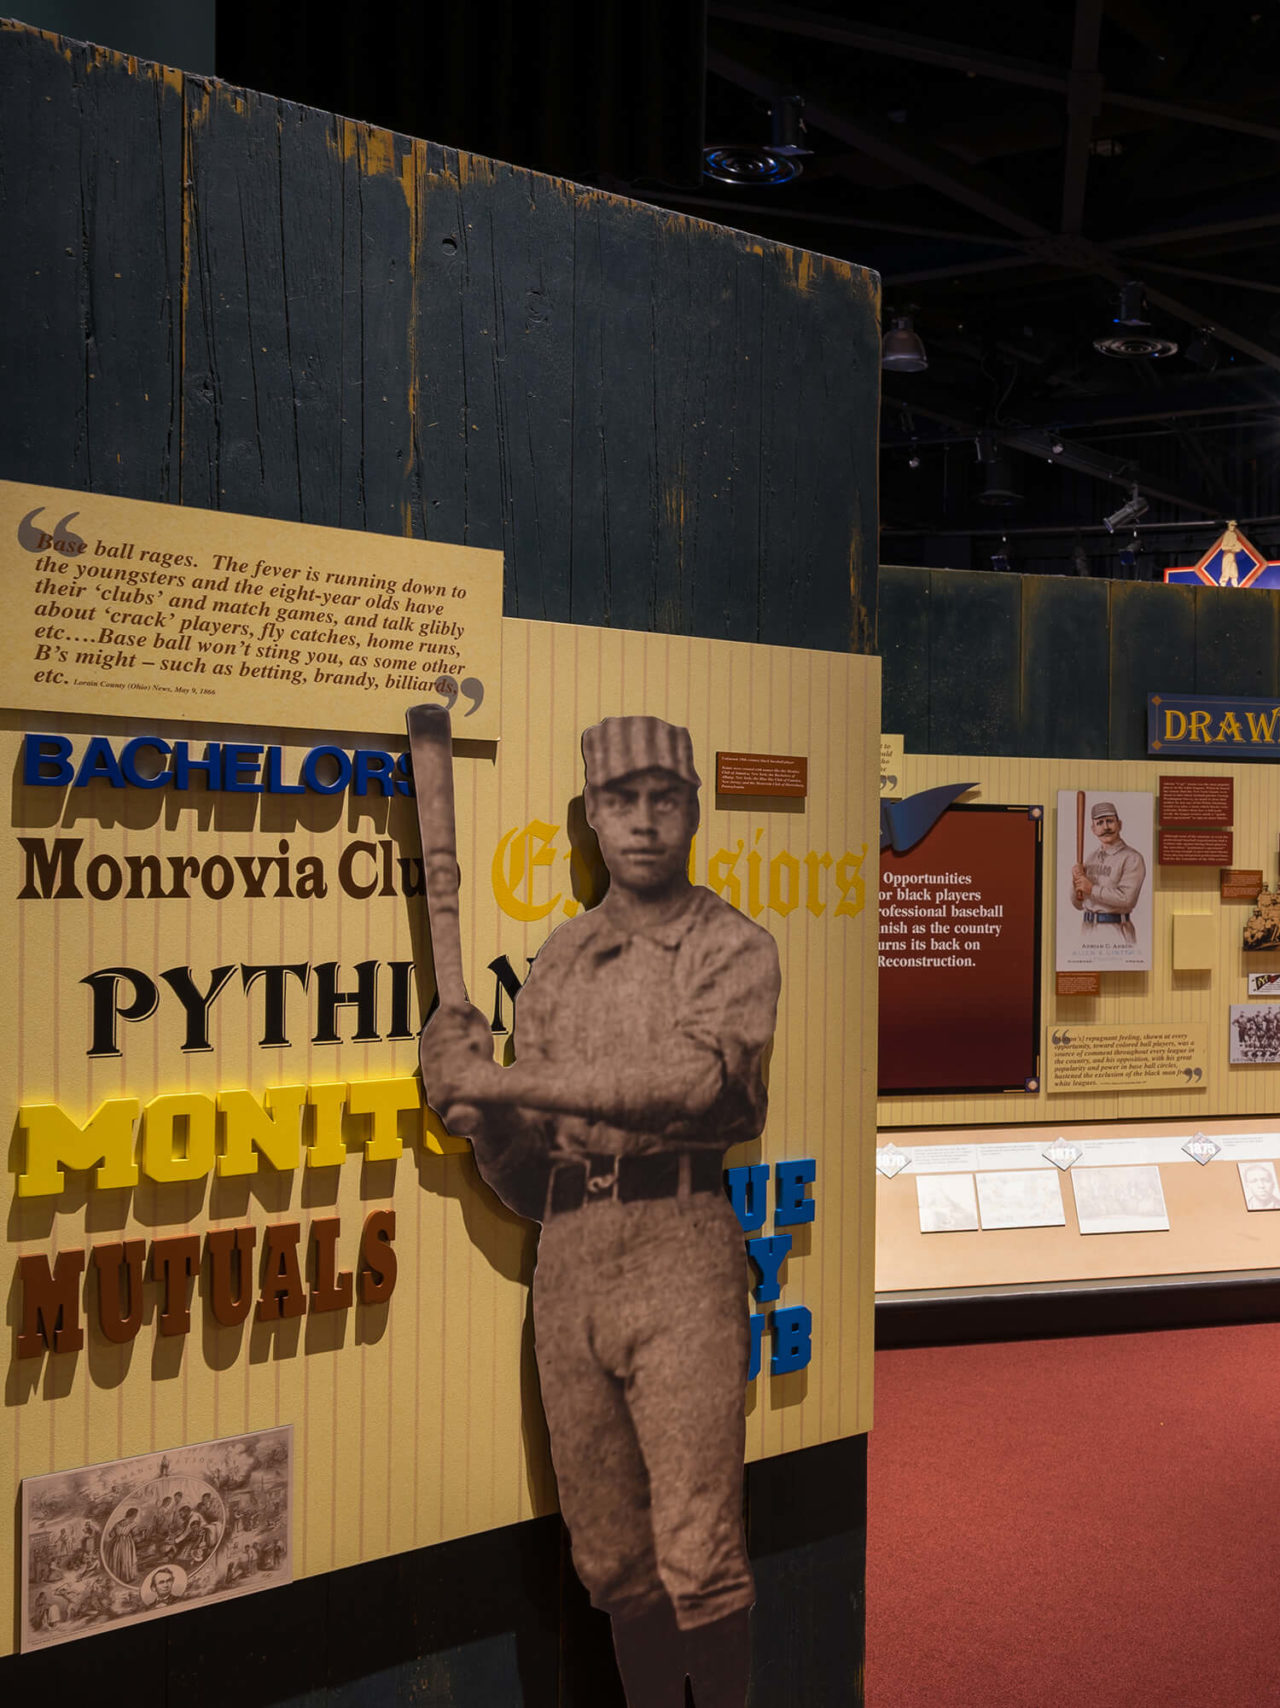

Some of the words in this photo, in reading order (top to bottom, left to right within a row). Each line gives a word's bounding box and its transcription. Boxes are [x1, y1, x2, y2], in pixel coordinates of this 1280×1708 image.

[35, 556, 68, 574] the
[74, 564, 185, 587] youngsters
[192, 577, 229, 592] and
[234, 579, 263, 596] the
[270, 583, 361, 606] eight-year
[366, 595, 399, 611] olds
[405, 599, 444, 615] have
[36, 533, 88, 554] Base
[94, 540, 134, 560] ball
[140, 550, 198, 568] rages.
[212, 554, 249, 573] The
[251, 560, 301, 579] fever
[306, 567, 320, 581] is
[325, 574, 397, 594] running
[402, 578, 446, 597] down
[452, 586, 467, 599] to
[35, 578, 87, 597] their
[169, 595, 207, 610] and
[213, 600, 270, 616] match
[276, 607, 338, 626] games,
[345, 614, 378, 628] and
[383, 616, 414, 632] talk
[419, 620, 464, 640] glibly
[35, 601, 96, 621] about
[179, 616, 254, 638] players,
[258, 622, 285, 642] fly
[290, 628, 360, 648] catches,
[367, 633, 413, 651] home
[419, 643, 461, 658] runs,
[76, 649, 137, 670] might
[160, 658, 207, 673] such
[213, 663, 232, 676] as
[240, 661, 307, 685] betting,
[314, 668, 379, 690] brandy,
[386, 674, 458, 695] billiards,
[154, 633, 192, 651] ball
[256, 644, 301, 664] sting
[305, 651, 343, 667] you,
[349, 654, 368, 666] as
[374, 656, 416, 671] some
[422, 660, 466, 675] other
[34, 670, 69, 684] etc.
[100, 681, 125, 689] County
[175, 687, 189, 695] May
[17, 837, 326, 900] Monrovia
[339, 840, 461, 900] Clu
[883, 872, 972, 887] Opportunities
[879, 892, 892, 900] or
[897, 889, 931, 900] black
[936, 889, 981, 904] players
[879, 905, 946, 917] ofessional
[951, 905, 1003, 918] baseball
[878, 941, 906, 950] urns
[911, 939, 926, 950] its
[931, 938, 960, 950] back
[964, 941, 980, 950] on
[879, 922, 907, 934] nish
[912, 926, 926, 934] as
[931, 922, 950, 934] the
[954, 923, 1001, 936] country
[878, 955, 975, 967] Reconstruction.
[17, 1209, 397, 1359] MUTUALS
